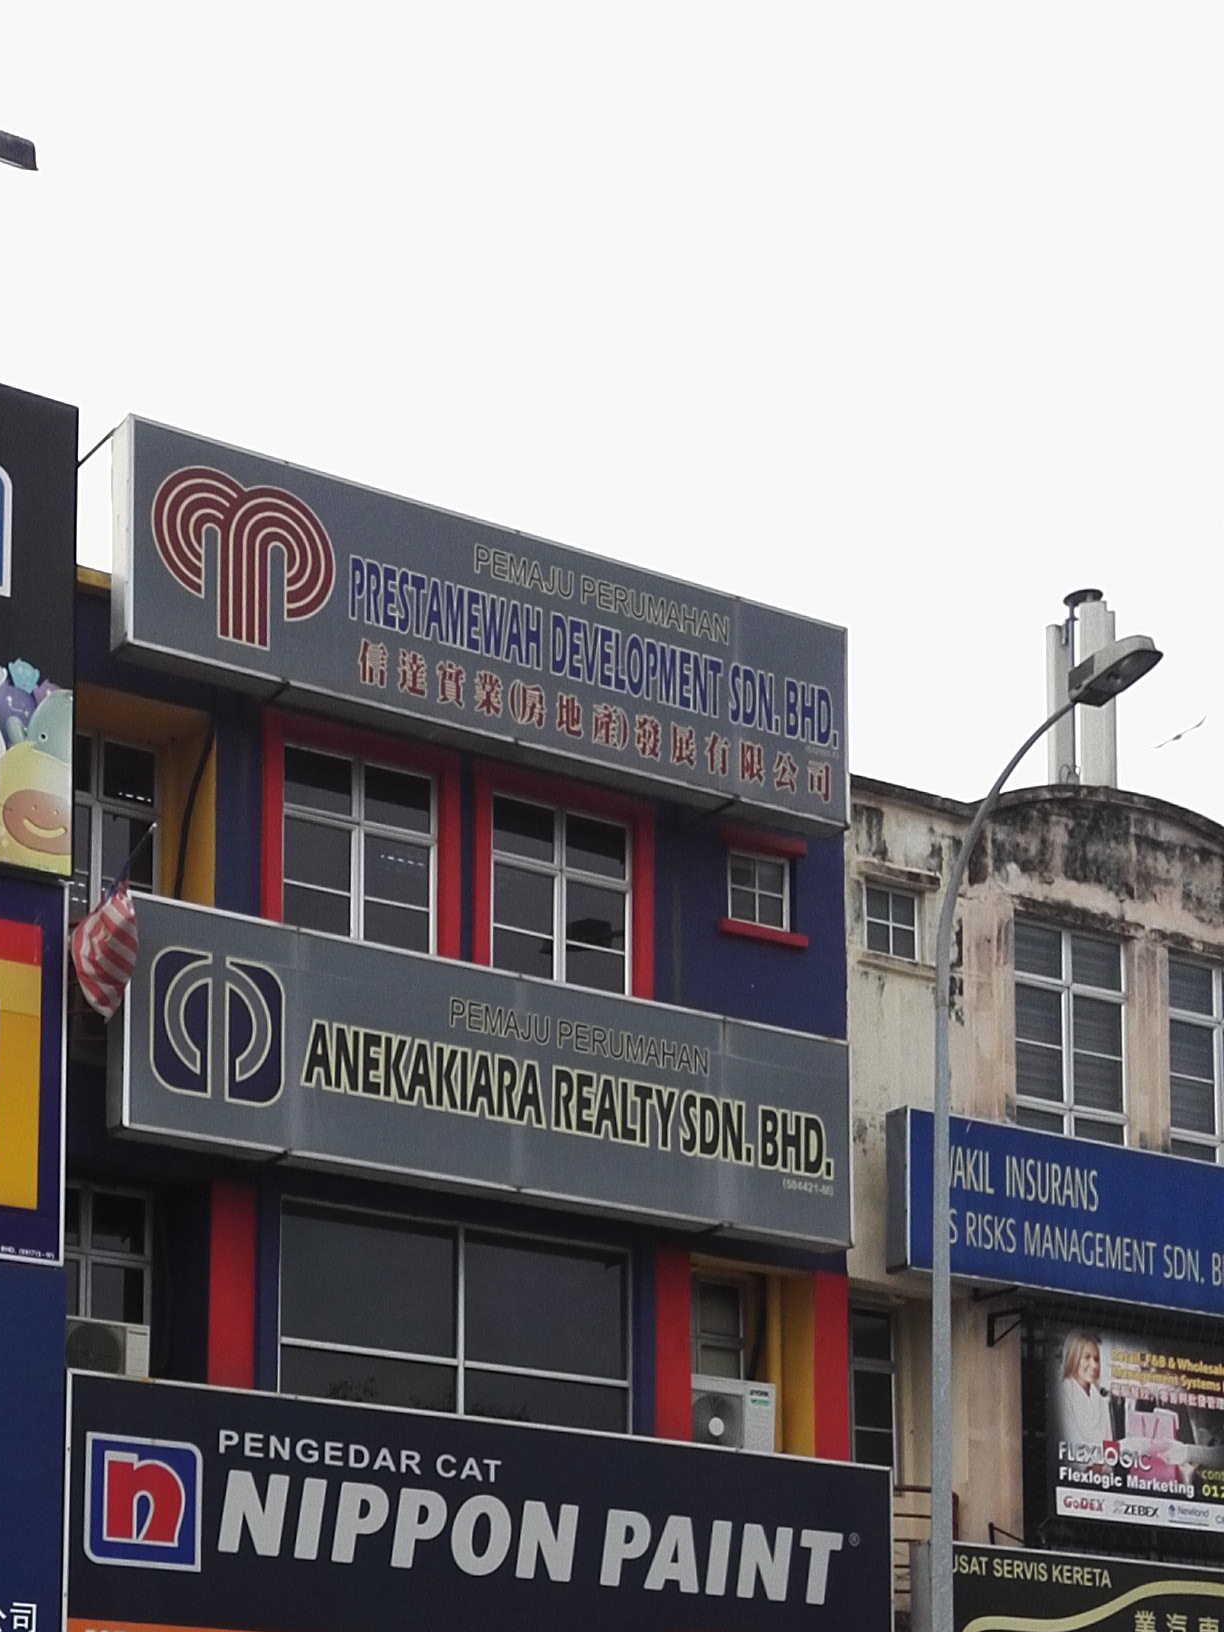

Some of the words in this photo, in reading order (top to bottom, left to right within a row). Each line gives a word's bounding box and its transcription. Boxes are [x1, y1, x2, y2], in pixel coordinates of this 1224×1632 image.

[474, 543, 575, 598] PEMAJU
[580, 576, 730, 645] PERUMAHAN
[348, 554, 543, 670] PRESTAMEWAH
[550, 611, 724, 718] DEVELOPMENT
[729, 664, 780, 735] SDN.
[784, 678, 840, 749] BHD.
[449, 997, 549, 1047] PEMAJU
[556, 1020, 710, 1076] PERUMAHAN
[300, 1019, 544, 1129] ANEKAKIARA
[552, 1067, 680, 1149] REALTY
[678, 1096, 754, 1165] SDN.
[757, 1106, 834, 1180] BHD.
[1005, 1154, 1099, 1212] INSURANS
[966, 1211, 1017, 1254] RISKS
[1023, 1221, 1158, 1270] MANAGEMENT
[1162, 1243, 1205, 1285] SDN.
[217, 1429, 421, 1477] PENGEDAR
[435, 1453, 503, 1484] CAT
[1058, 1466, 1123, 1489] Flexlogic
[1126, 1475, 1195, 1499] Marketing
[217, 1469, 579, 1583] NIPPON
[600, 1508, 844, 1606] PAINT
[993, 1558, 1048, 1582] SERVIS
[1052, 1564, 1112, 1589] KERETA
